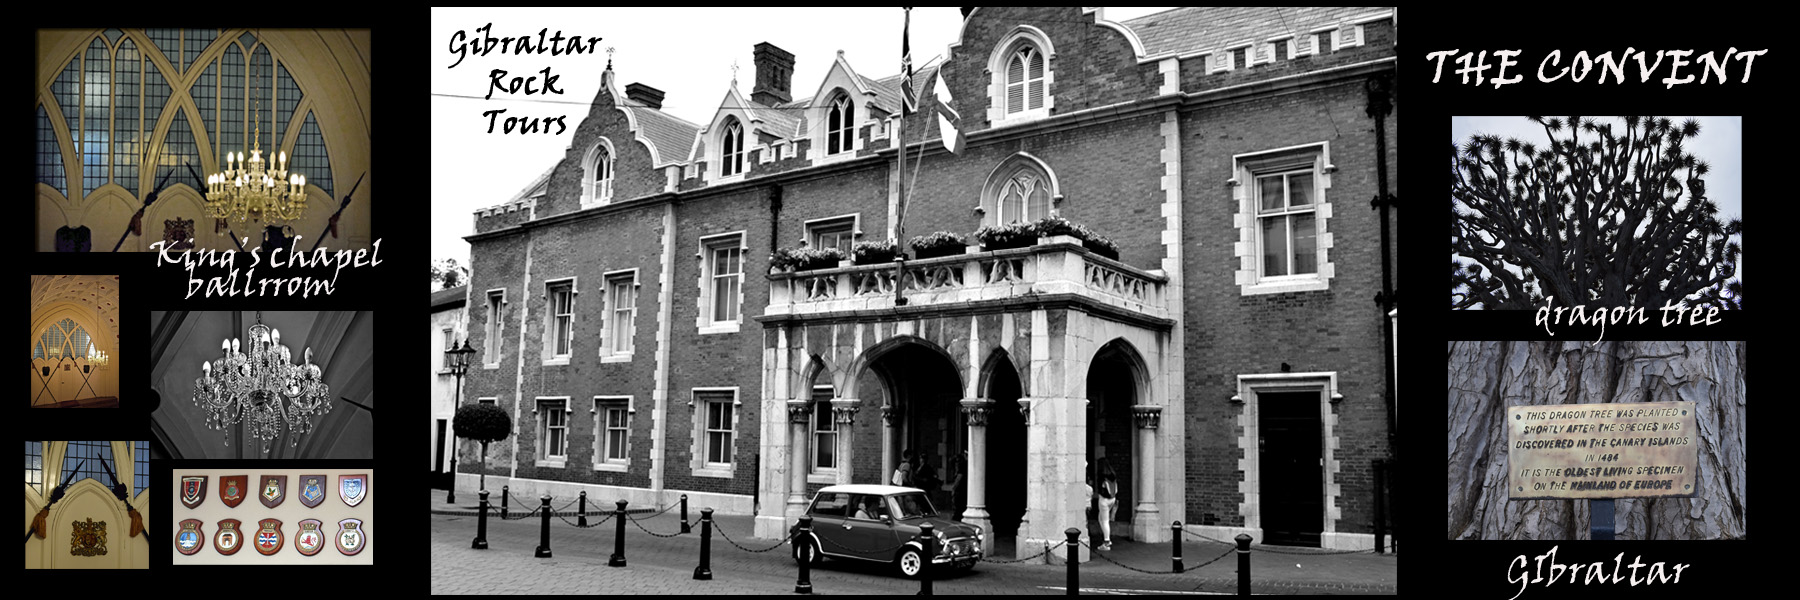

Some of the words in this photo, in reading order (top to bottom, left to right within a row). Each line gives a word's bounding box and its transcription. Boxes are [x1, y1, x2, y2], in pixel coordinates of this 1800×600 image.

[1526, 411, 1547, 421] THIS
[1549, 410, 1587, 420] DRAGON
[1590, 409, 1614, 419] TREE
[1616, 409, 1635, 419] WAS
[1636, 407, 1679, 418] PLANTED
[1523, 425, 1565, 435] SHORTLY
[1566, 424, 1596, 434] AFTER
[1598, 423, 1617, 433] THE
[1619, 422, 1660, 433] SPECIES
[1662, 421, 1681, 431] WAS
[1515, 438, 1575, 450] DISCOVERED
[1577, 439, 1588, 449] IN
[1589, 438, 1608, 449] THE
[1610, 437, 1647, 448] CANARY
[1648, 436, 1689, 447] ISLANDS
[1584, 454, 1595, 463] IN
[1597, 453, 1620, 462] 1484
[1520, 468, 1531, 478] IT
[1531, 468, 1542, 477] IS
[1544, 468, 1562, 477] THE
[1563, 467, 1603, 478] OLDEST
[1602, 466, 1634, 477] LIVING
[1636, 465, 1685, 476] SPECIMEN
[1533, 481, 1547, 491] ON
[1549, 480, 1568, 491] THE
[1618, 479, 1633, 490] OF
[1633, 479, 1674, 490] EUROPE
